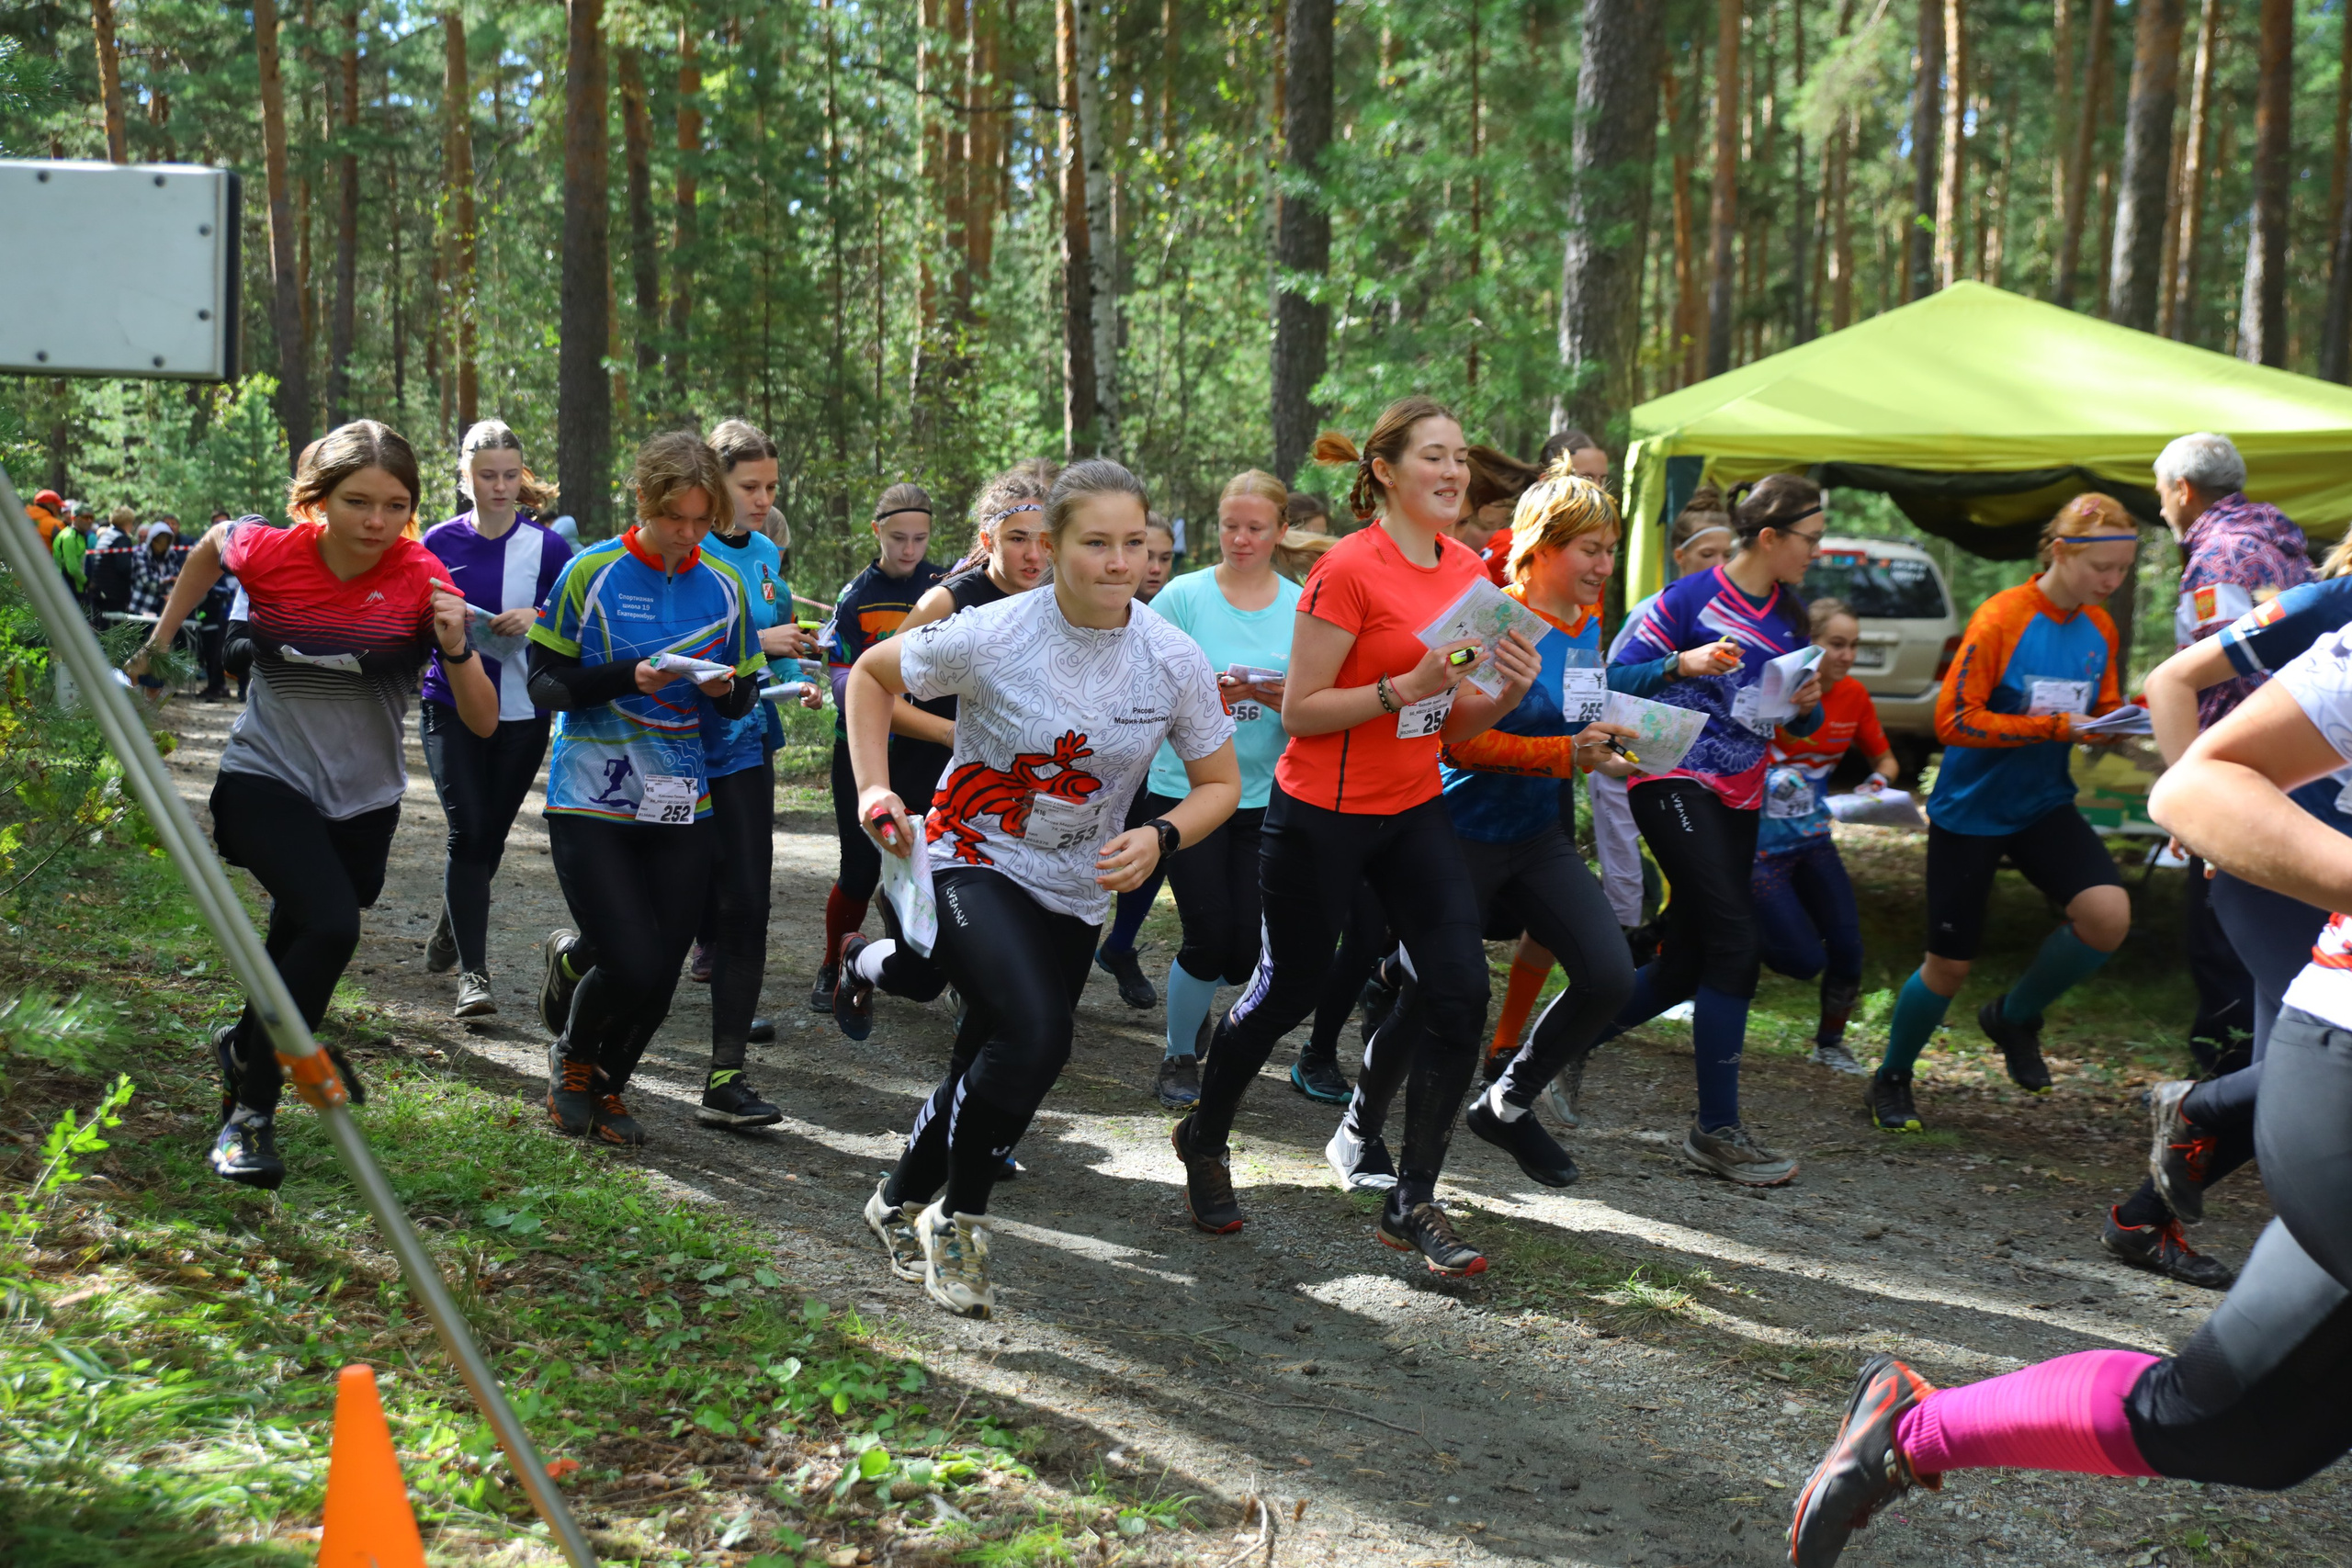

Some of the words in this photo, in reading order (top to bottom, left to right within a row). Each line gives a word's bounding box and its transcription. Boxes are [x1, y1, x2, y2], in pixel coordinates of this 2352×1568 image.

[618, 592, 654, 603] Спортивная
[616, 609, 656, 620] Екатеринбург
[1578, 702, 1603, 721] 255
[660, 805, 691, 822] 252
[1057, 824, 1099, 849] 253
